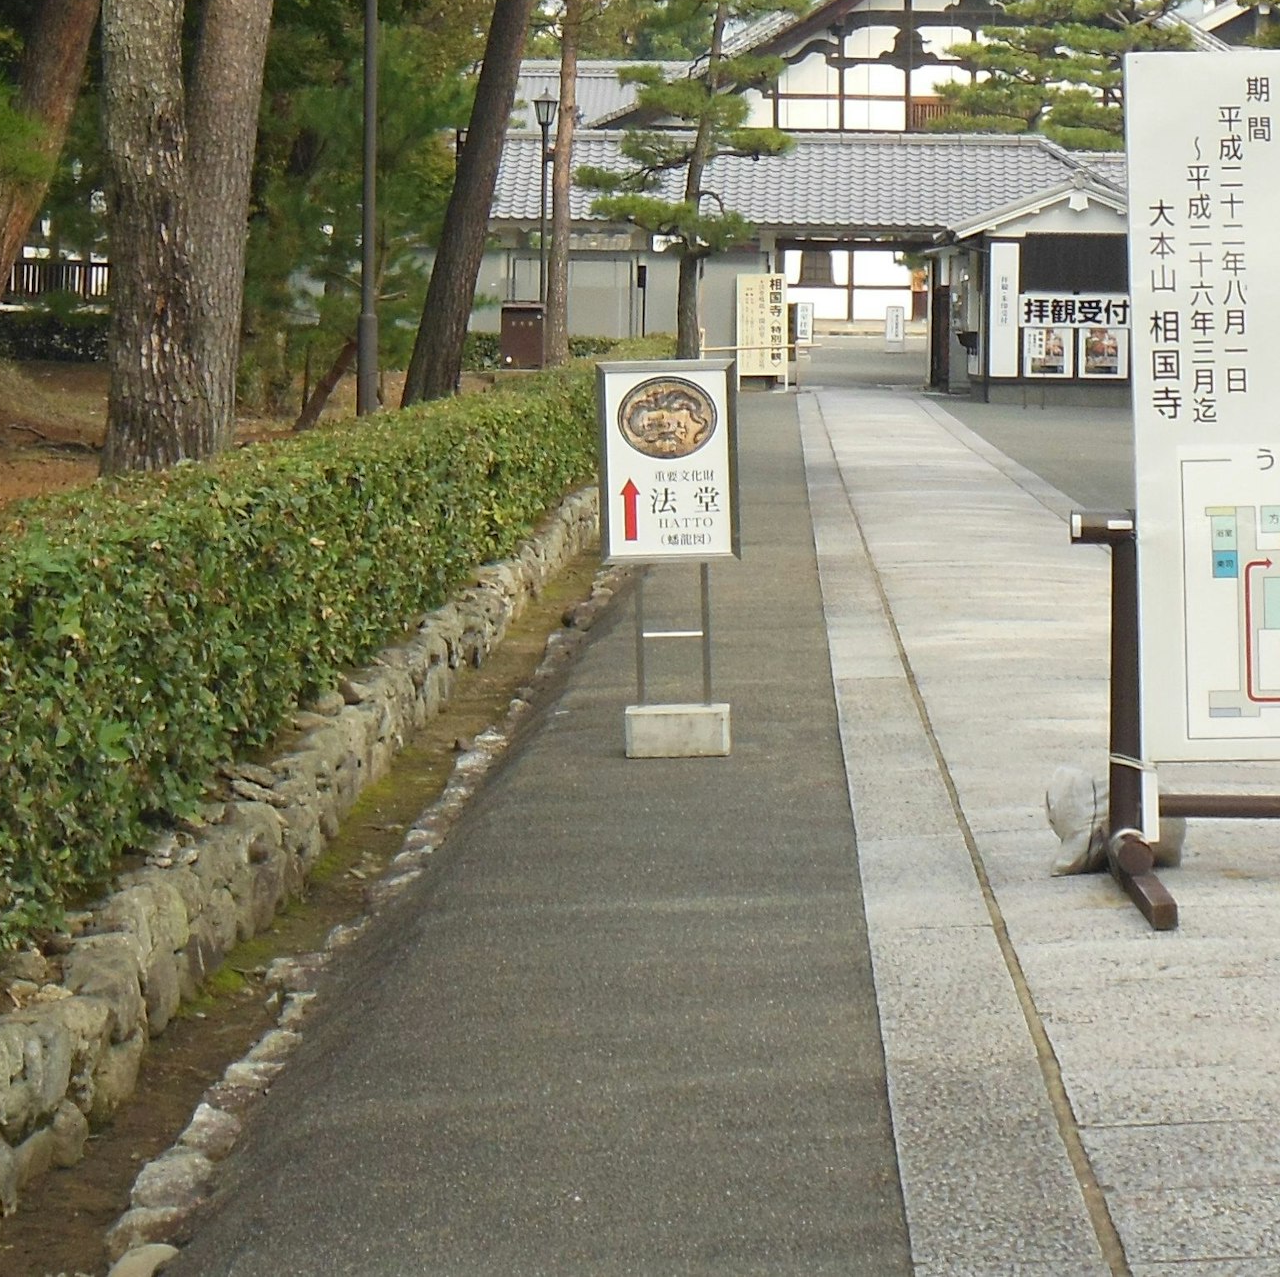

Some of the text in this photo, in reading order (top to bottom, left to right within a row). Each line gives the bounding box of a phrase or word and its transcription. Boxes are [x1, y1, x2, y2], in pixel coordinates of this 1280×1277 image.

[1246, 76, 1272, 142] 期間
[1218, 105, 1248, 393] 平成二十二年八月一日
[1024, 298, 1130, 325] 拝観受付
[654, 469, 714, 483] 重要文化財
[650, 486, 721, 515] 法堂
[658, 517, 714, 529] HATTO
